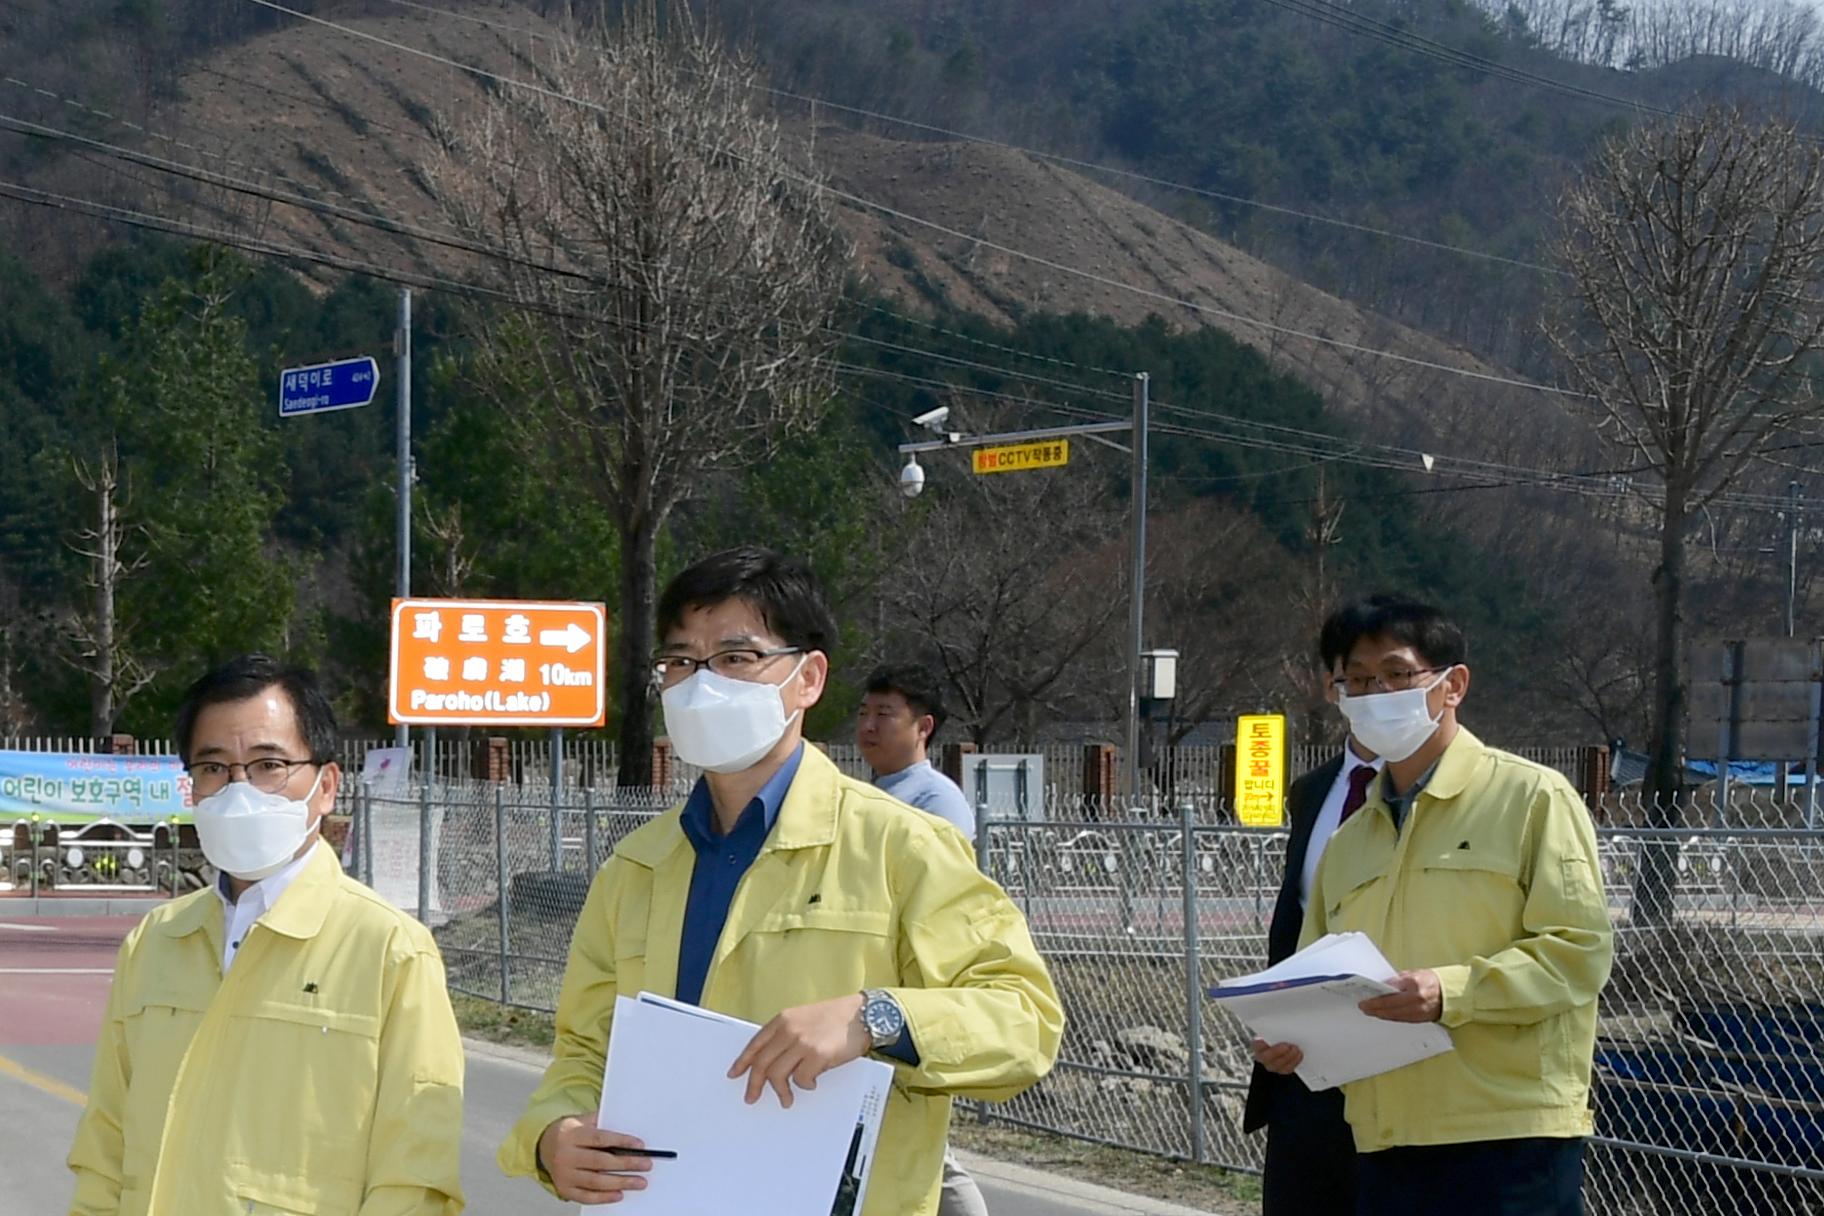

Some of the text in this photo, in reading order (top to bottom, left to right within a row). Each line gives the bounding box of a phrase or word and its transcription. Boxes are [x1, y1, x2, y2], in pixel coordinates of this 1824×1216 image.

[539, 662, 593, 686] 10km
[3, 776, 63, 804] 어린이
[71, 778, 142, 807] 보호구역
[150, 782, 169, 800] 내
